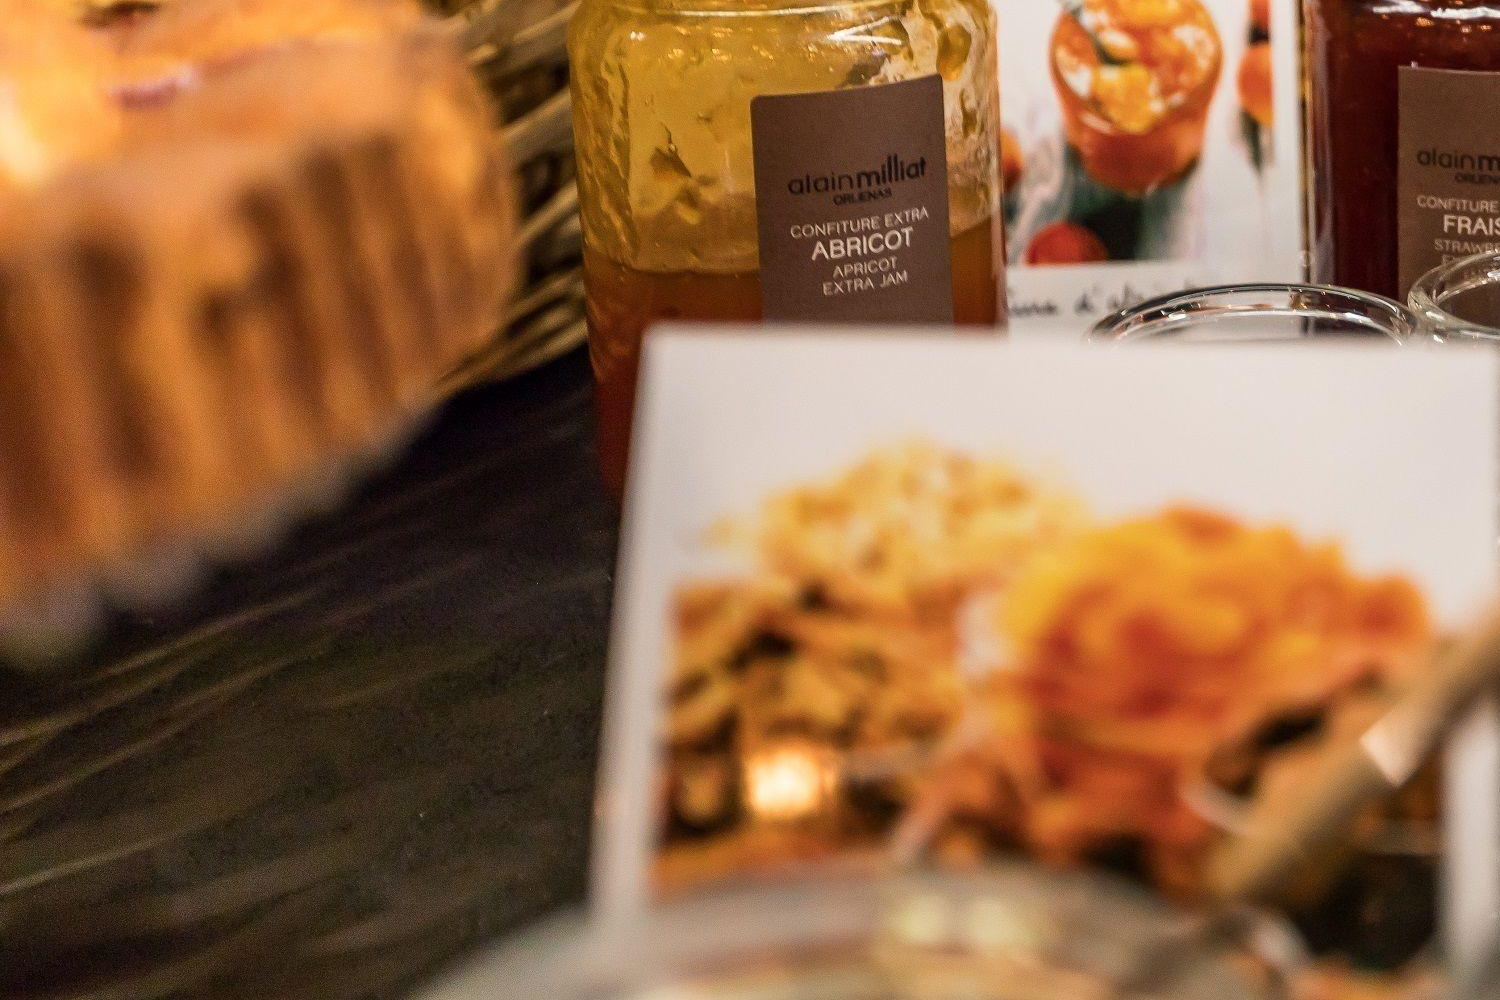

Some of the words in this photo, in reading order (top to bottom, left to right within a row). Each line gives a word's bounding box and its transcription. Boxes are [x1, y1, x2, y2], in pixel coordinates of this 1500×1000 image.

[1416, 194, 1499, 213] CONFITURE
[790, 216, 881, 239] CONFITURE
[884, 206, 930, 228] EXTRA
[811, 226, 914, 262] ABRICOT
[833, 256, 899, 279] APRICOT
[822, 279, 874, 296] EXTRA
[880, 270, 909, 288] JAM
